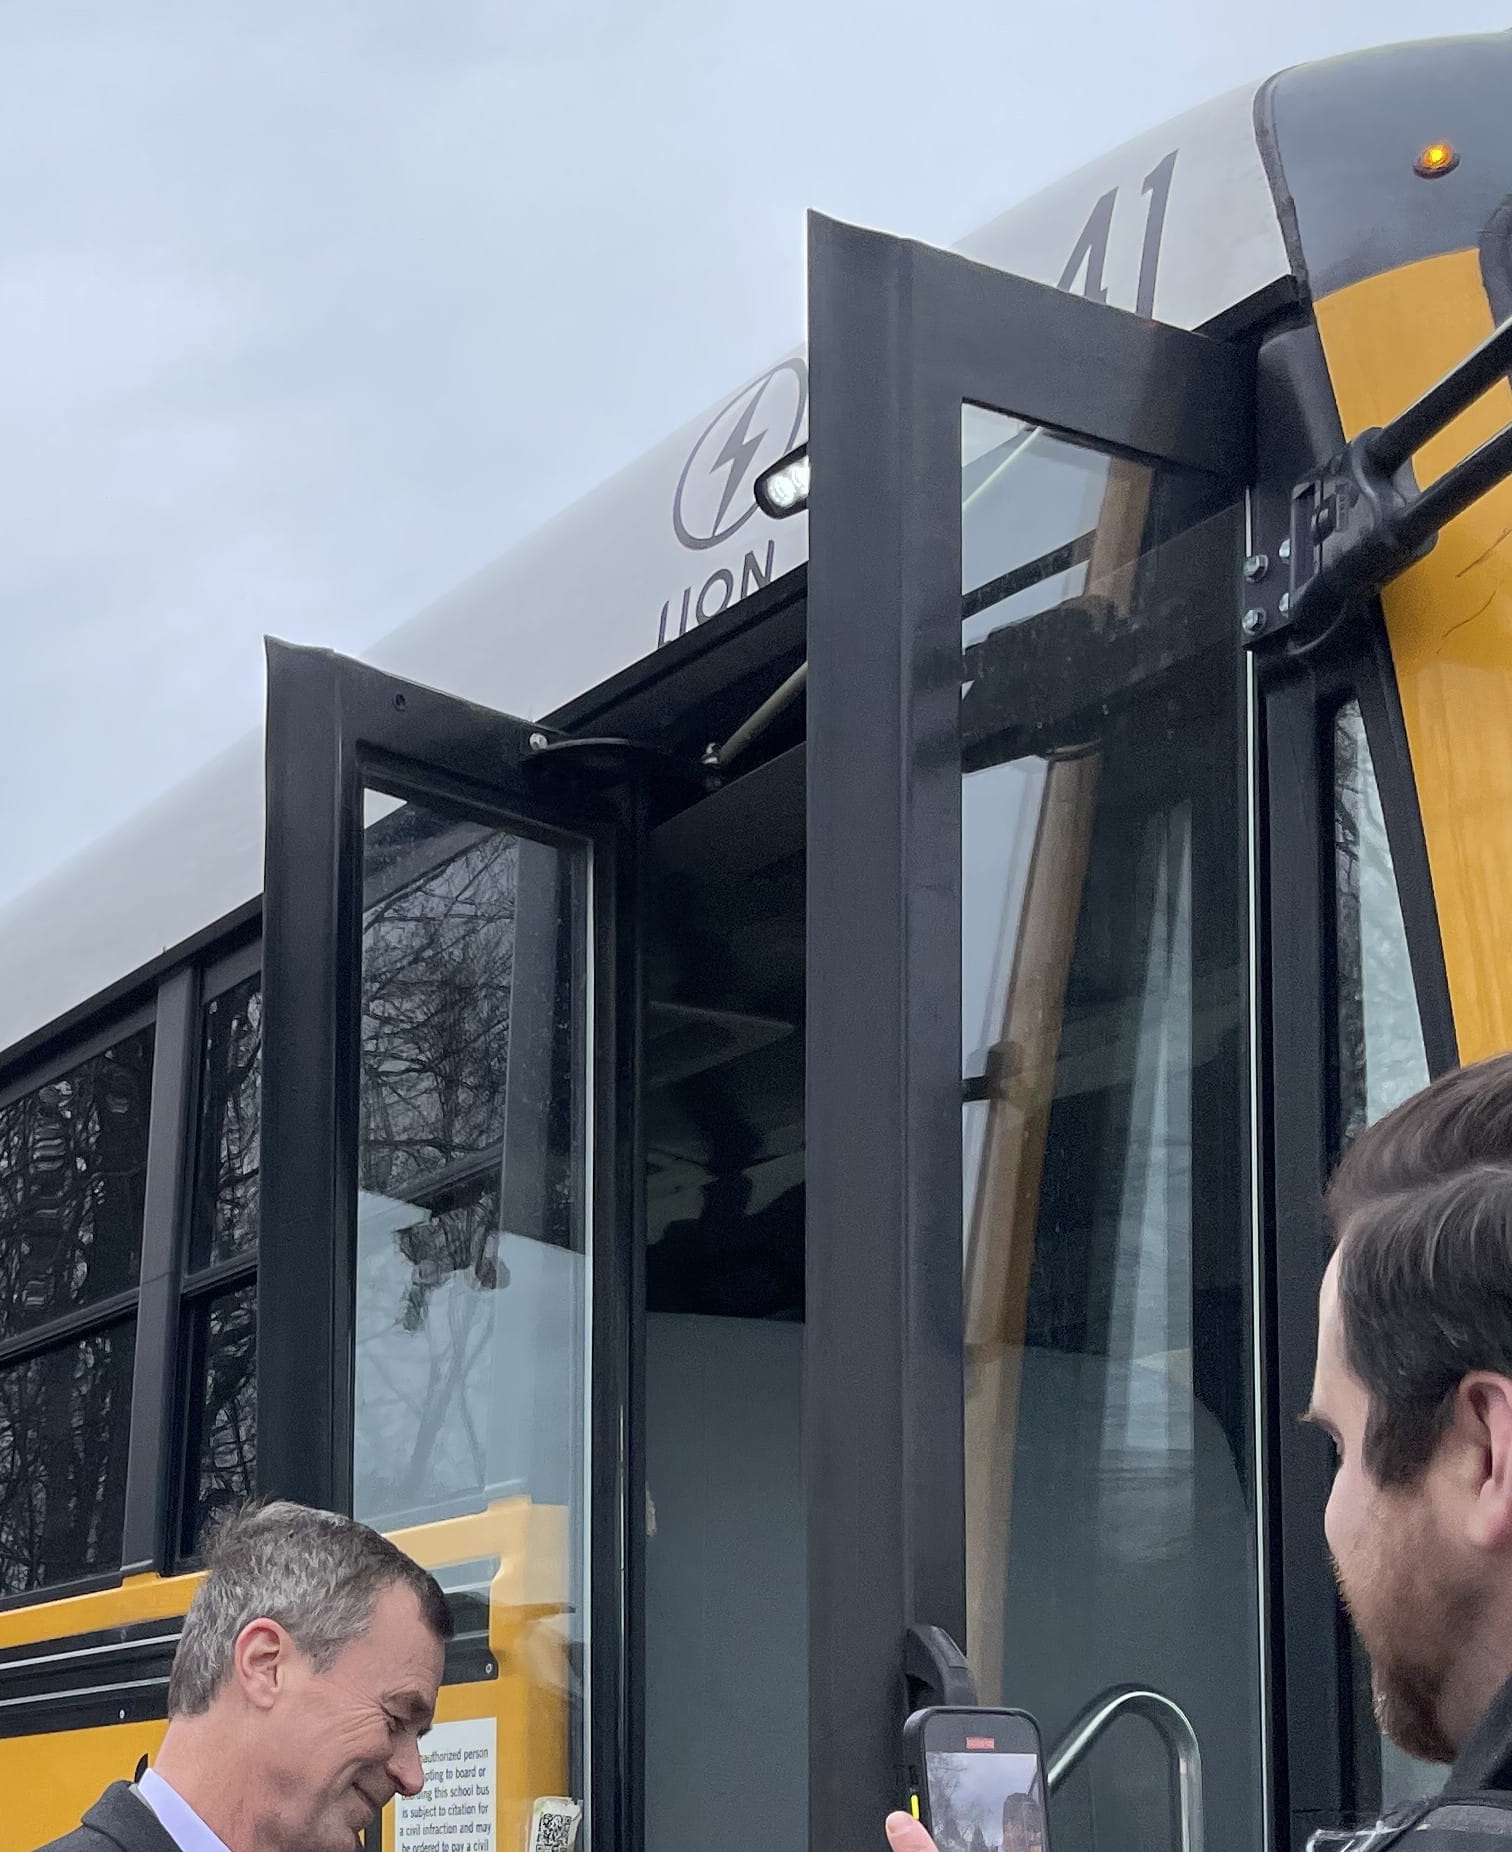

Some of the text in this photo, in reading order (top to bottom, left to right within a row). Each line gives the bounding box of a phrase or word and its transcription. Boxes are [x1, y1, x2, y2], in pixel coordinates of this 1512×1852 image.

[1056, 149, 1179, 320] 41
[657, 539, 775, 649] LION
[420, 1748, 488, 1763] authorized person
[446, 1768, 453, 1779] to
[455, 1765, 476, 1779] board
[478, 1768, 486, 1777] or
[434, 1787, 448, 1799] this
[449, 1784, 474, 1798] school
[476, 1783, 489, 1796] bus
[402, 1801, 489, 1820] is subject to citation for
[399, 1821, 492, 1836] a civil infraction and may
[442, 1841, 449, 1852] to
[466, 1842, 471, 1852] a
[473, 1839, 489, 1852] civil
